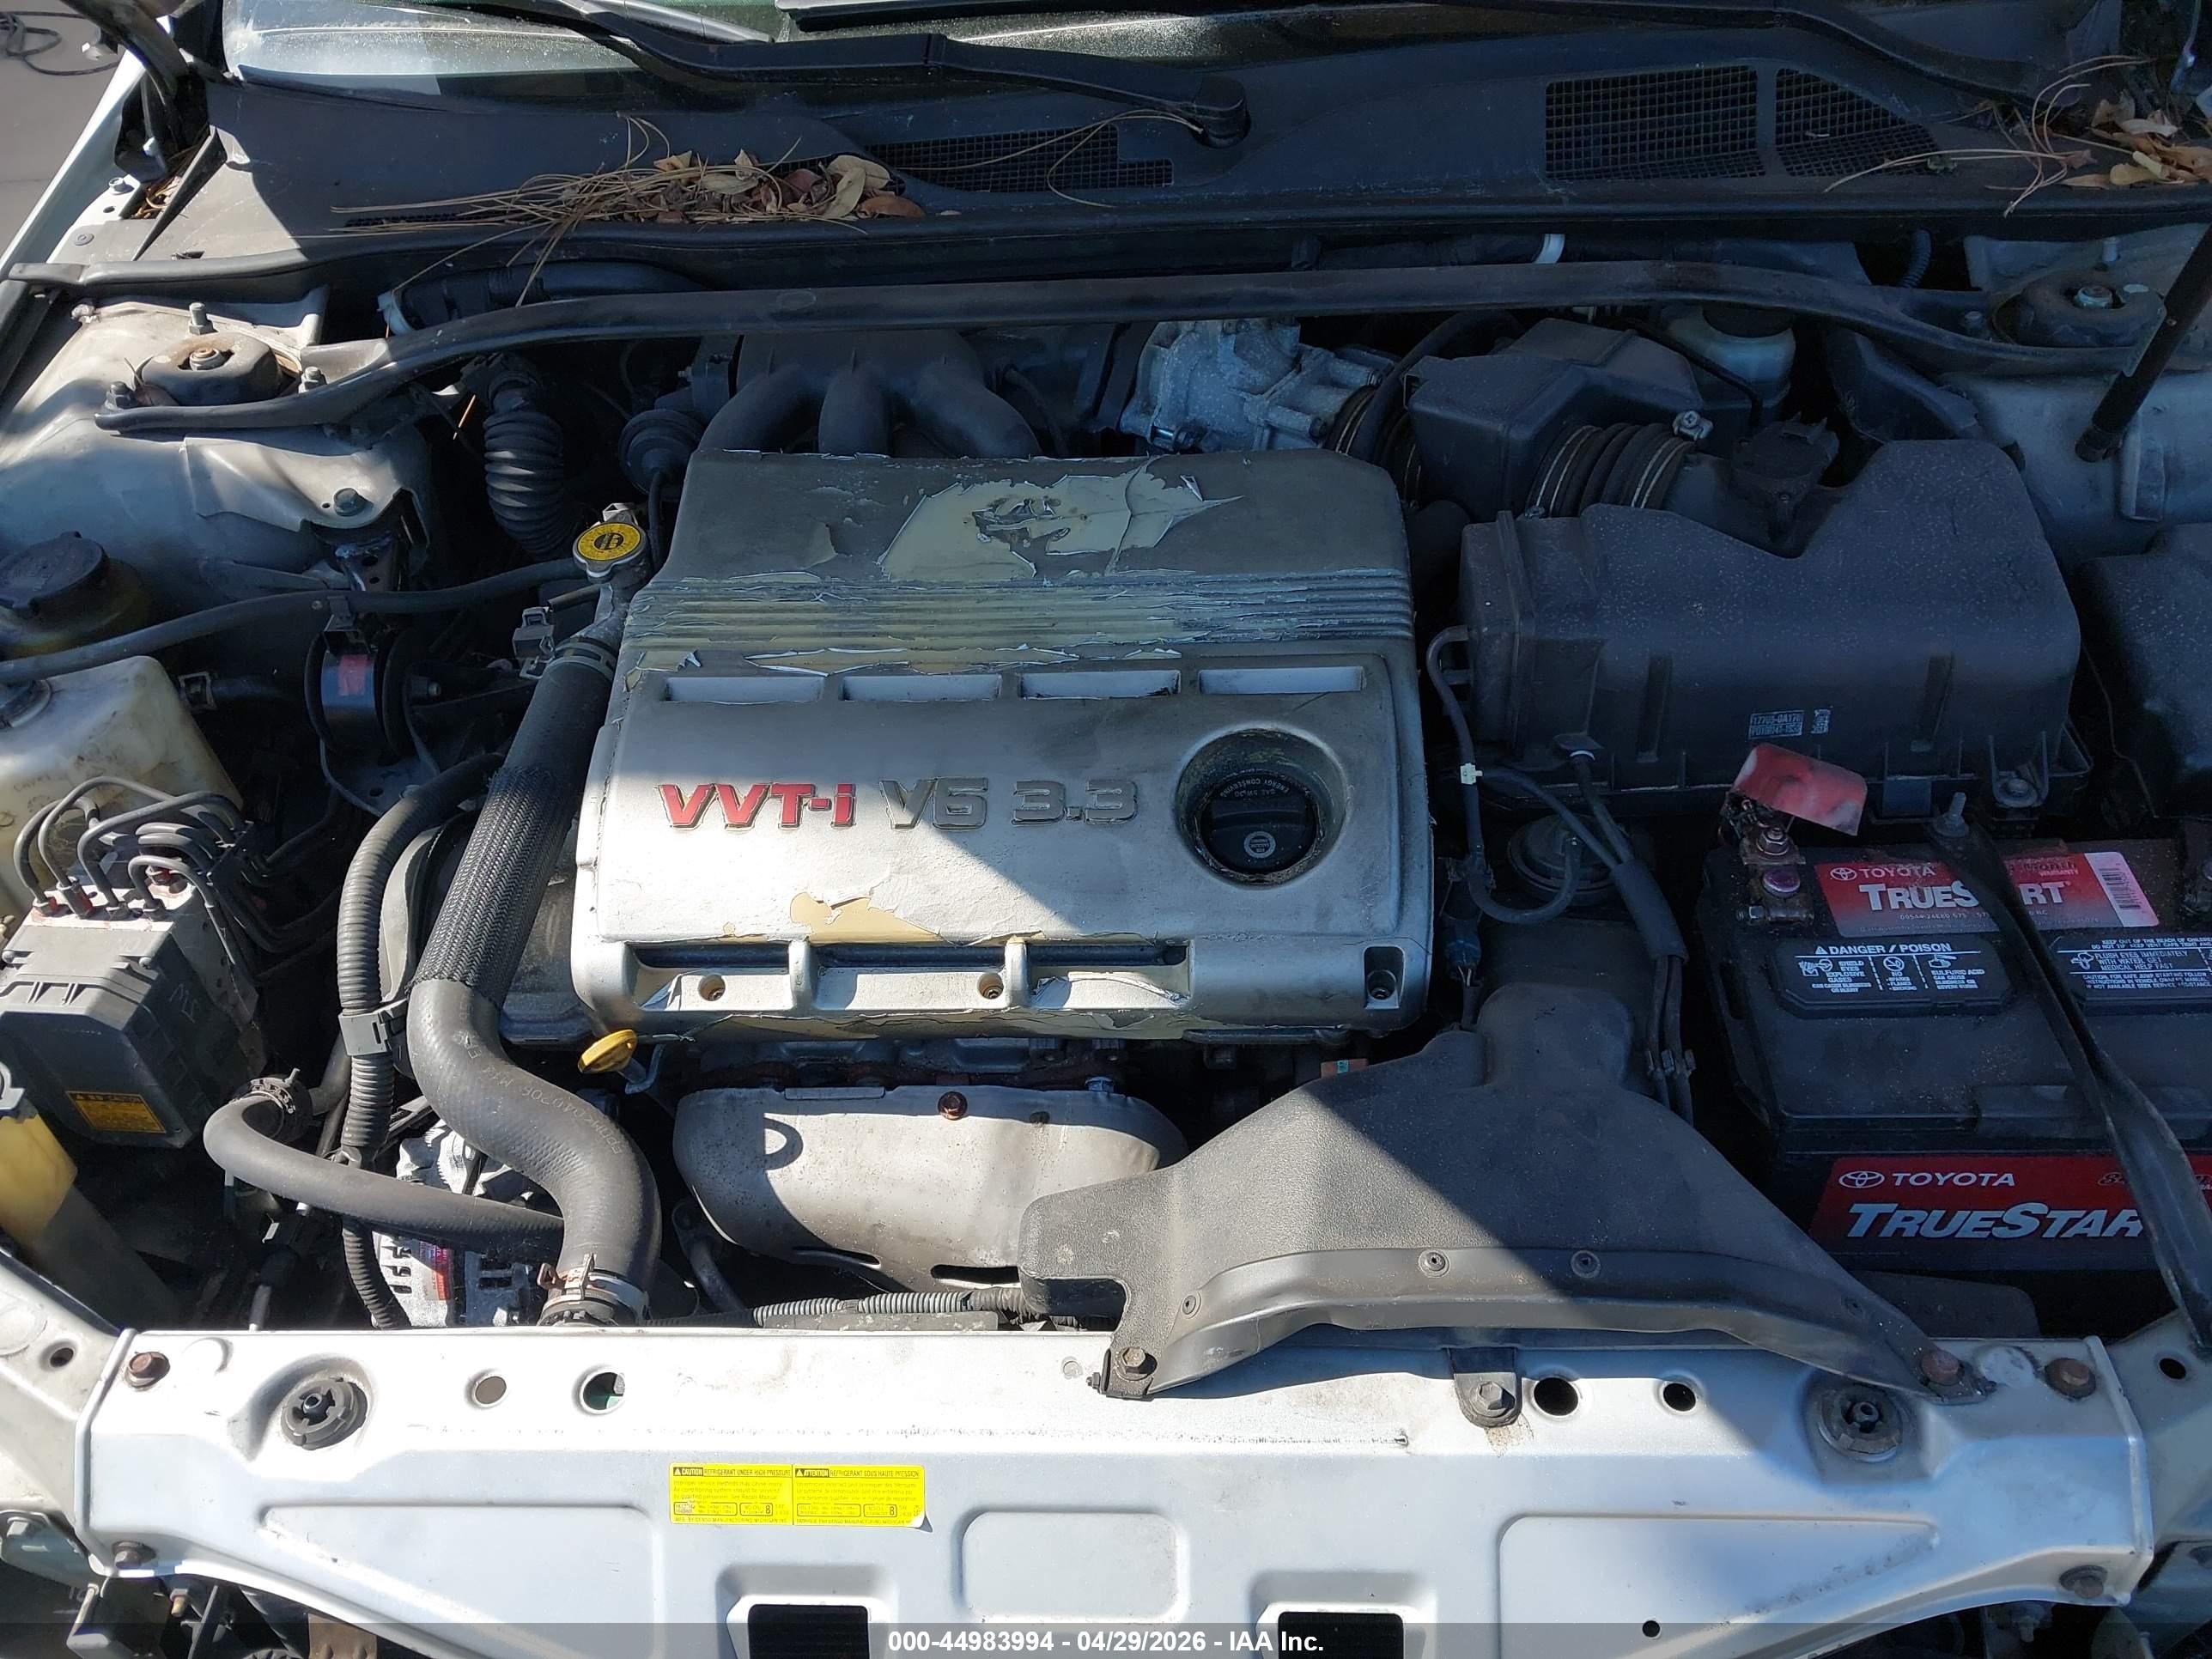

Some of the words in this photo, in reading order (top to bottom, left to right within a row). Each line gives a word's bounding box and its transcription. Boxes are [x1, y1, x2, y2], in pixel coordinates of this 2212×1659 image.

[659, 781, 856, 830] VVT-i
[880, 777, 989, 831] V6
[1011, 777, 1139, 826] 3.3
[1858, 866, 1936, 879] TOYOTA
[1858, 879, 2065, 911] TRUESRT
[1828, 945, 1886, 955] DANGER
[1888, 944, 1897, 953] /
[1899, 943, 1952, 953] POISON
[1891, 1171, 2016, 1188] TOYOTA
